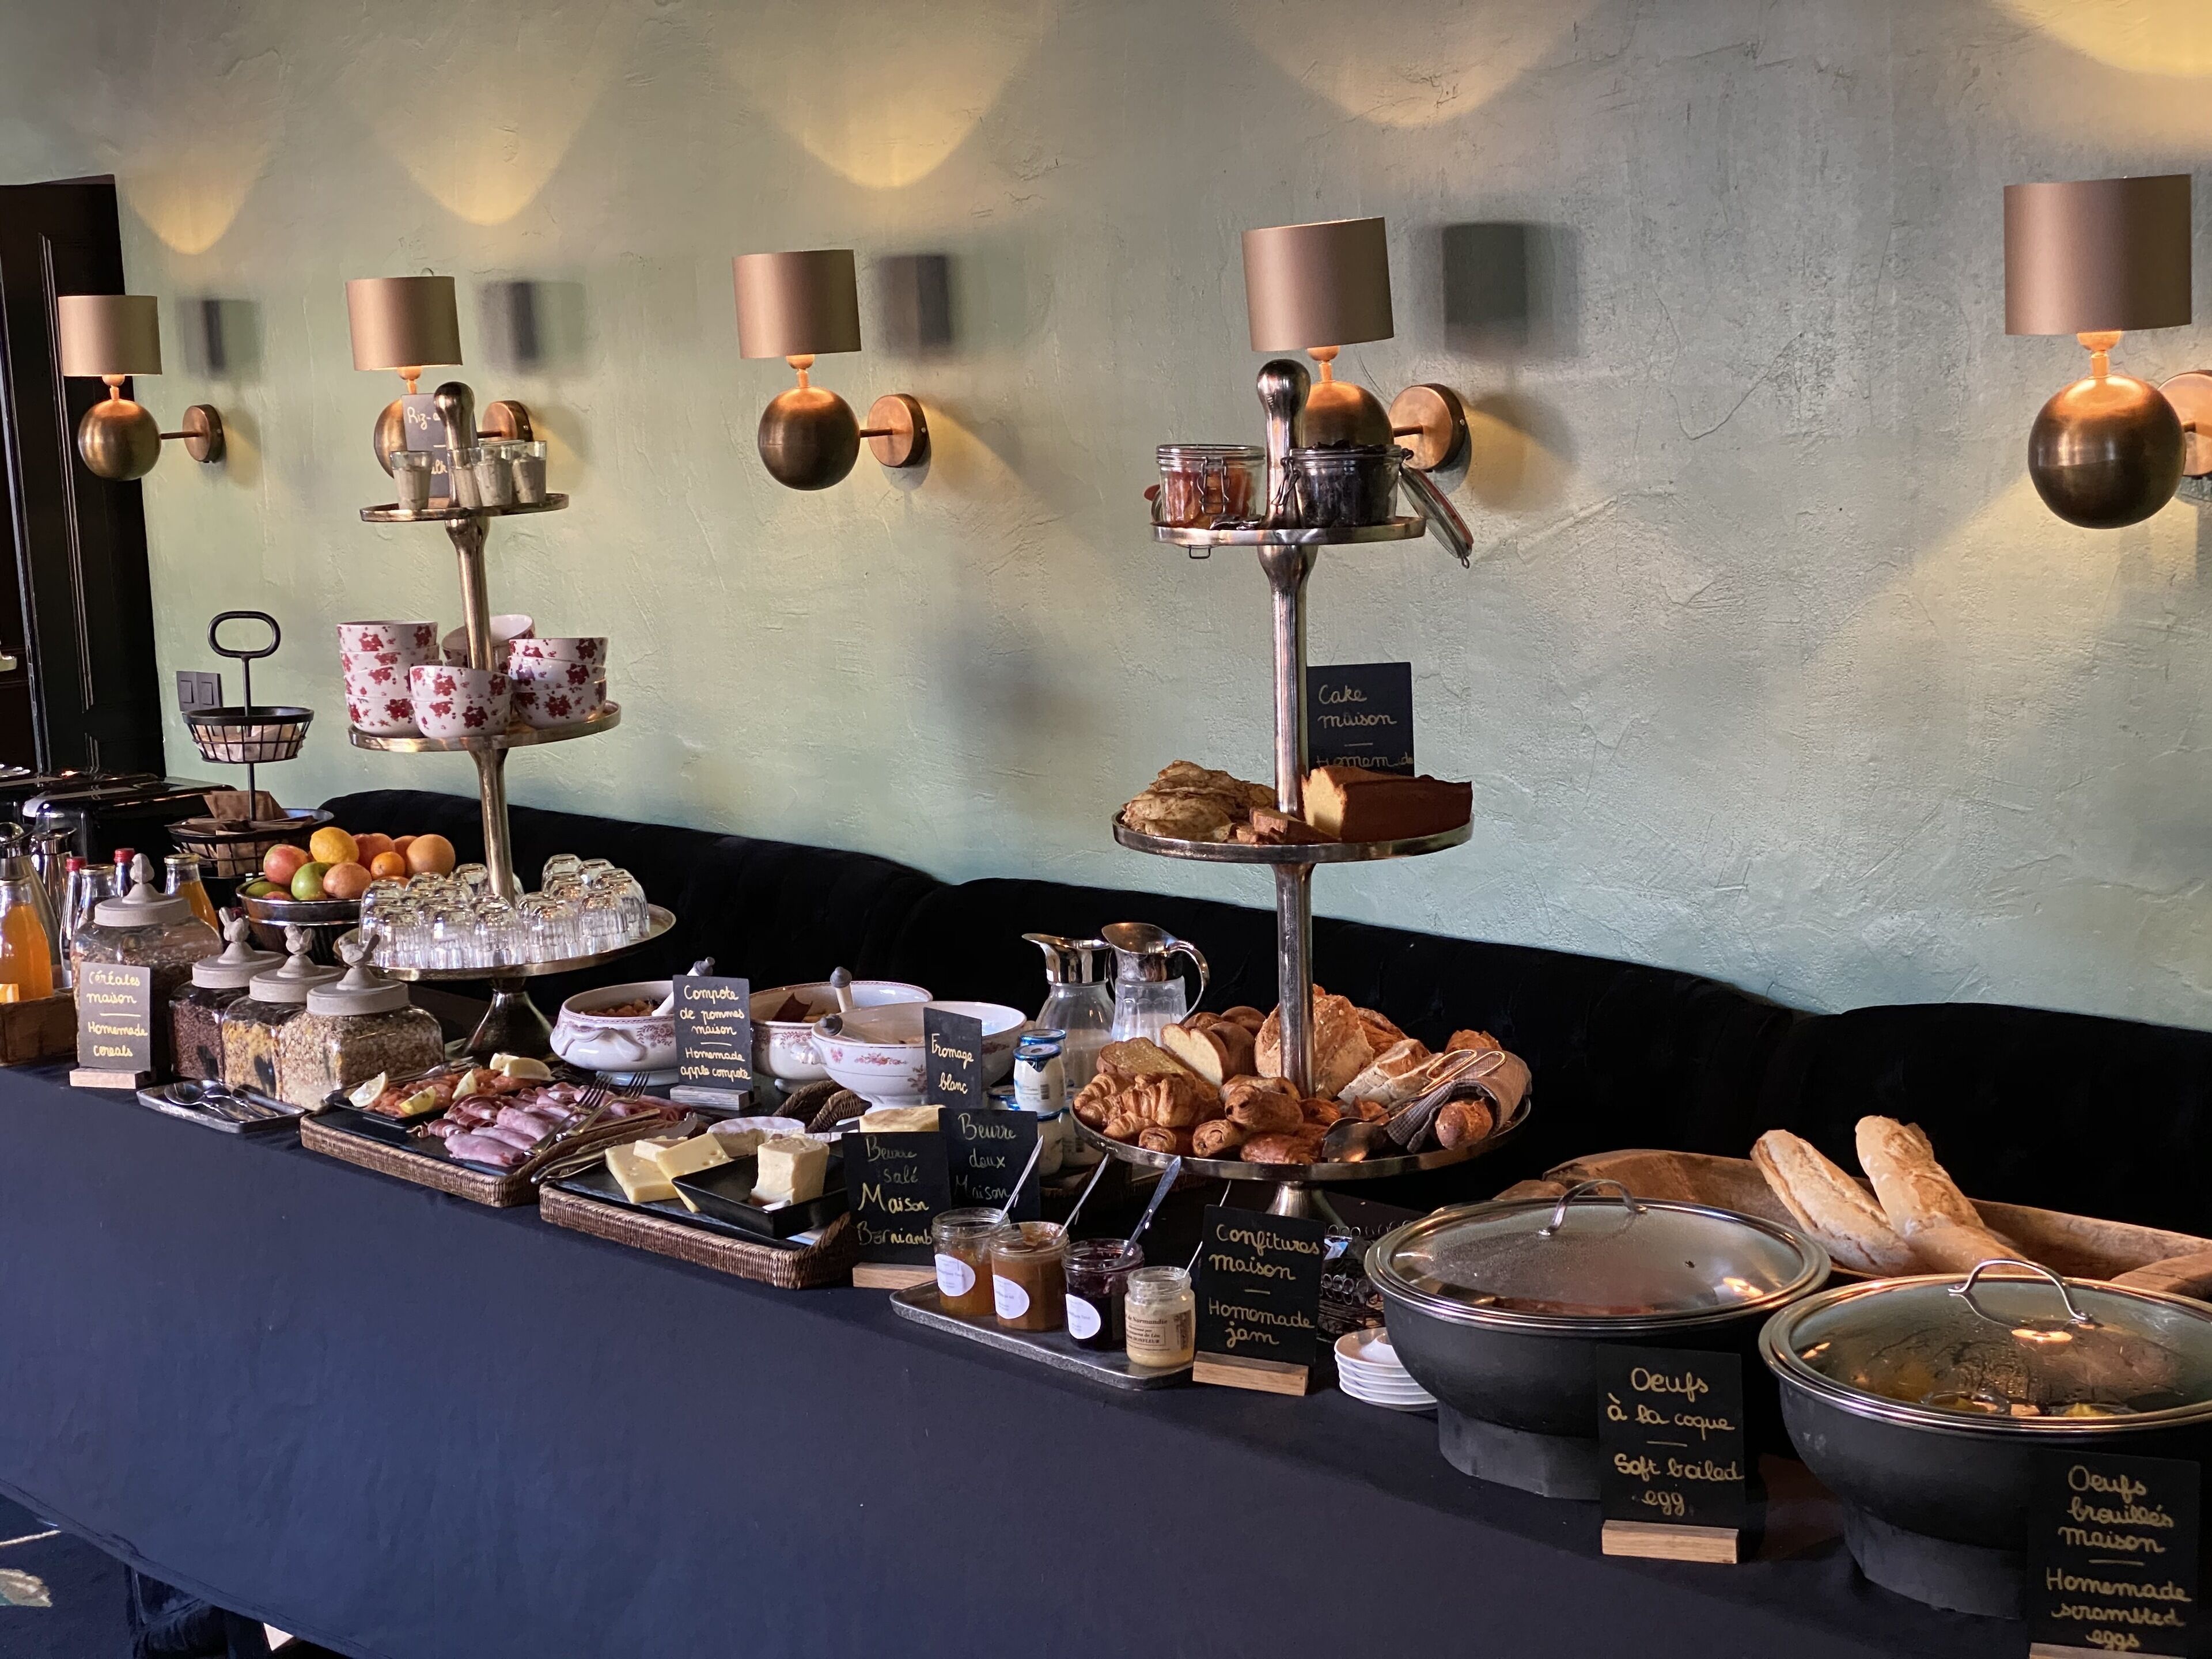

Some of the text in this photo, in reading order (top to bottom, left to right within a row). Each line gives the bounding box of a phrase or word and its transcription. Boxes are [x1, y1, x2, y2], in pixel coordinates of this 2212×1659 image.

[1319, 684, 1367, 704] Cake
[1317, 712, 1397, 729] maison
[89, 971, 141, 986] Céréales
[86, 993, 137, 1004] maison
[684, 984, 738, 1004] Compote
[88, 1021, 148, 1036] Homemade
[680, 1007, 745, 1025] de pommes
[691, 1023, 737, 1035] maison
[685, 1047, 745, 1062] Homemade
[931, 1033, 974, 1070] Fromage
[680, 1065, 751, 1082] apple compote
[938, 1072, 968, 1094] blanc
[957, 1113, 1016, 1140] Beurre
[865, 1134, 917, 1162] Beurre
[969, 1147, 1005, 1168] doux
[858, 1183, 929, 1214] Maison
[954, 1175, 1011, 1200] Maison
[1217, 1224, 1320, 1256] Confitures
[1209, 1254, 1296, 1280] maison
[1209, 1297, 1315, 1329] Homemade
[1225, 1321, 1279, 1349] jam
[1631, 1368, 1709, 1402] Oeufs
[1607, 1392, 1735, 1441] à la coque
[1667, 1457, 1744, 1482] boiled
[2068, 1465, 2147, 1503] Oeufs
[1642, 1490, 1685, 1517] egg
[2058, 1527, 2166, 1553] maison
[2047, 1567, 2192, 1602] Homemade
[2051, 1603, 2187, 1627] scrambled
[2086, 1629, 2142, 1651] eggs
